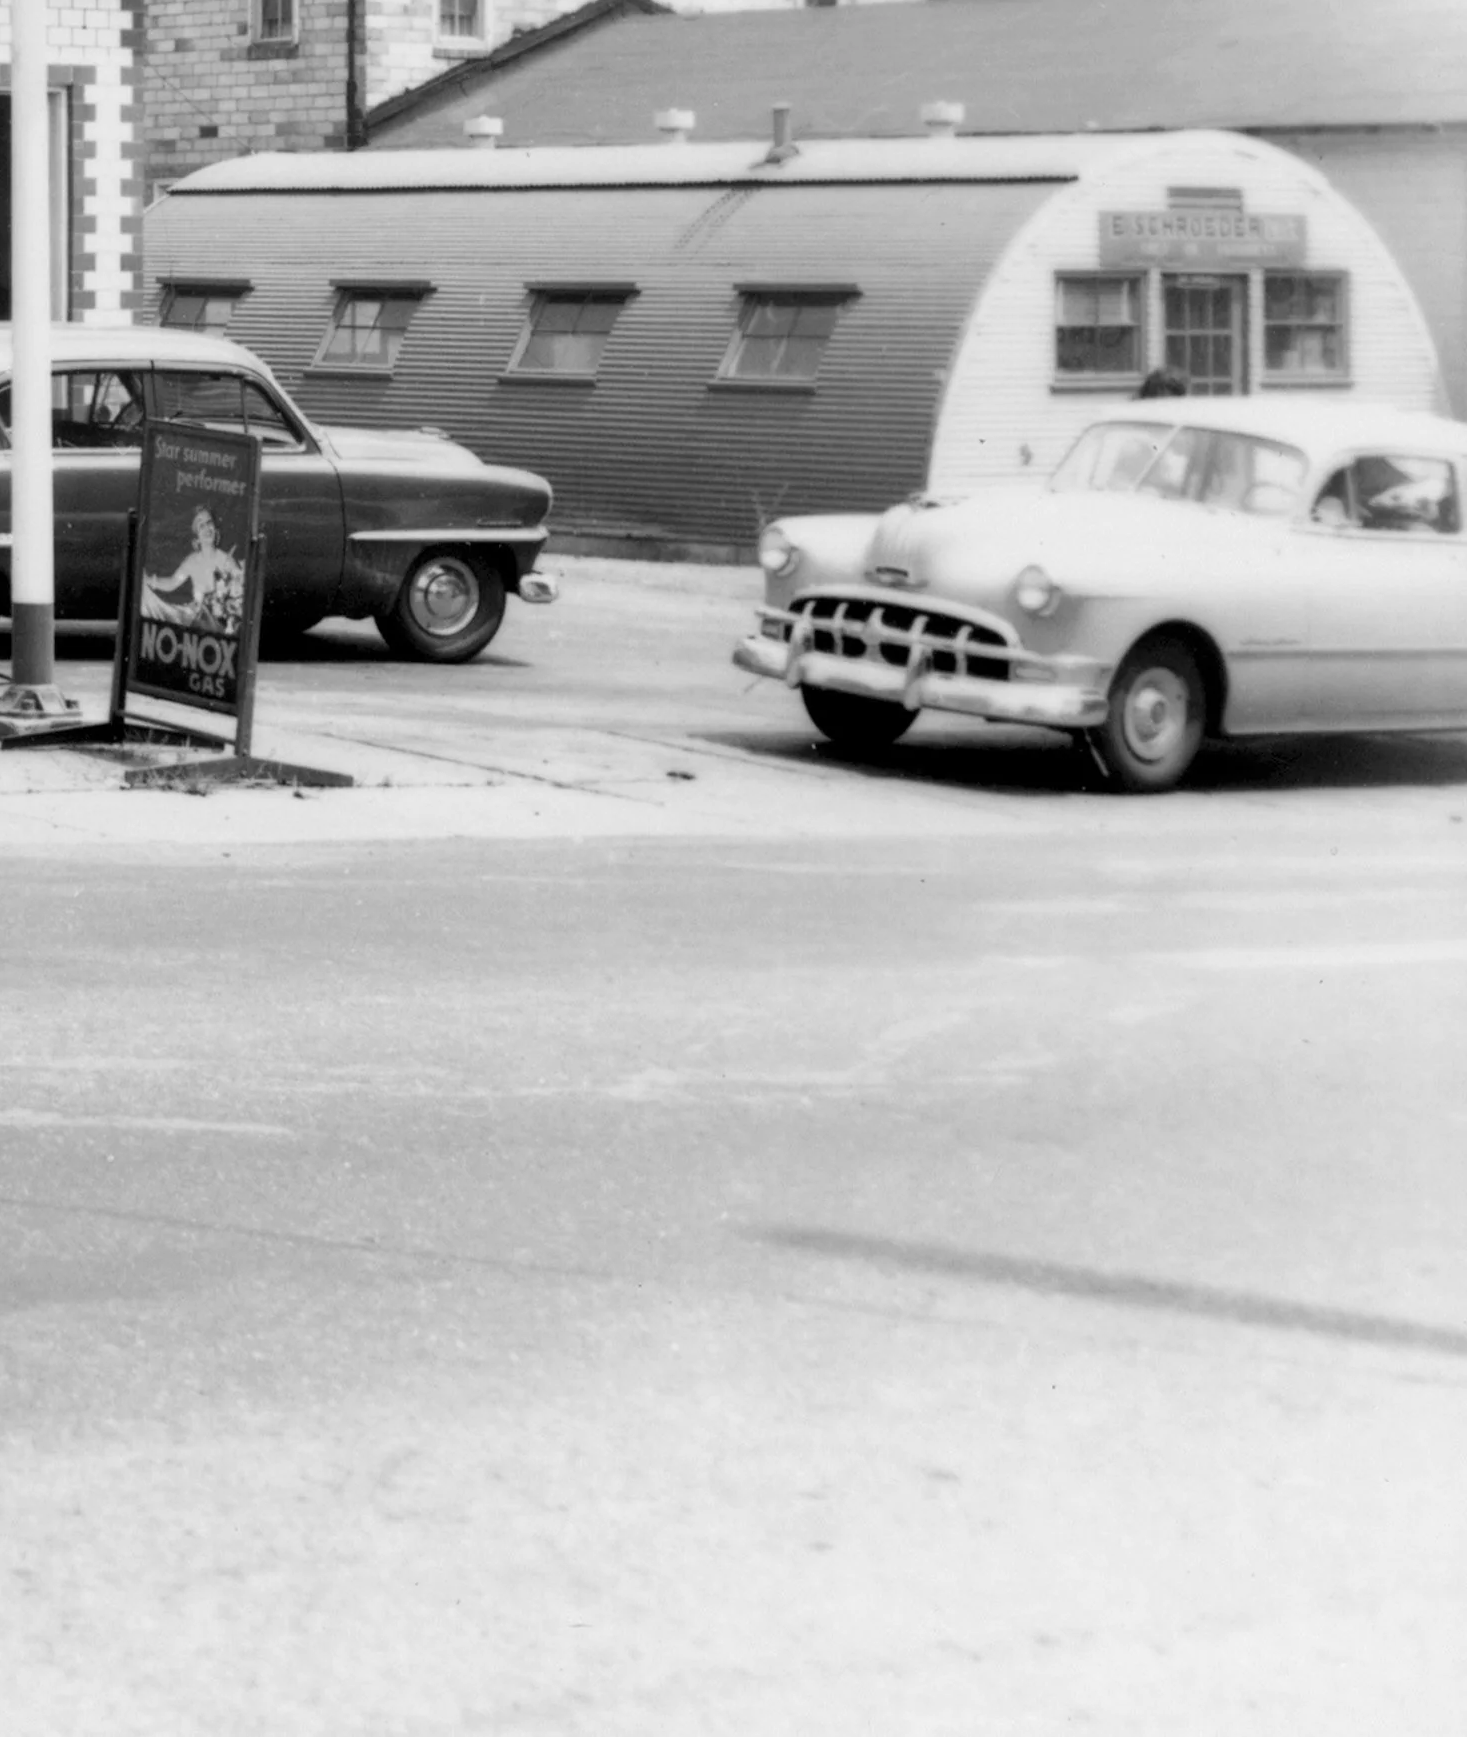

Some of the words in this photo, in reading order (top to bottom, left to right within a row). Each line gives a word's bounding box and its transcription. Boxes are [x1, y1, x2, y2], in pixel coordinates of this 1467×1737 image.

[1134, 215, 1261, 238] SCHROEDER
[141, 622, 237, 680] NO-NOX
[188, 672, 225, 698] GAS
